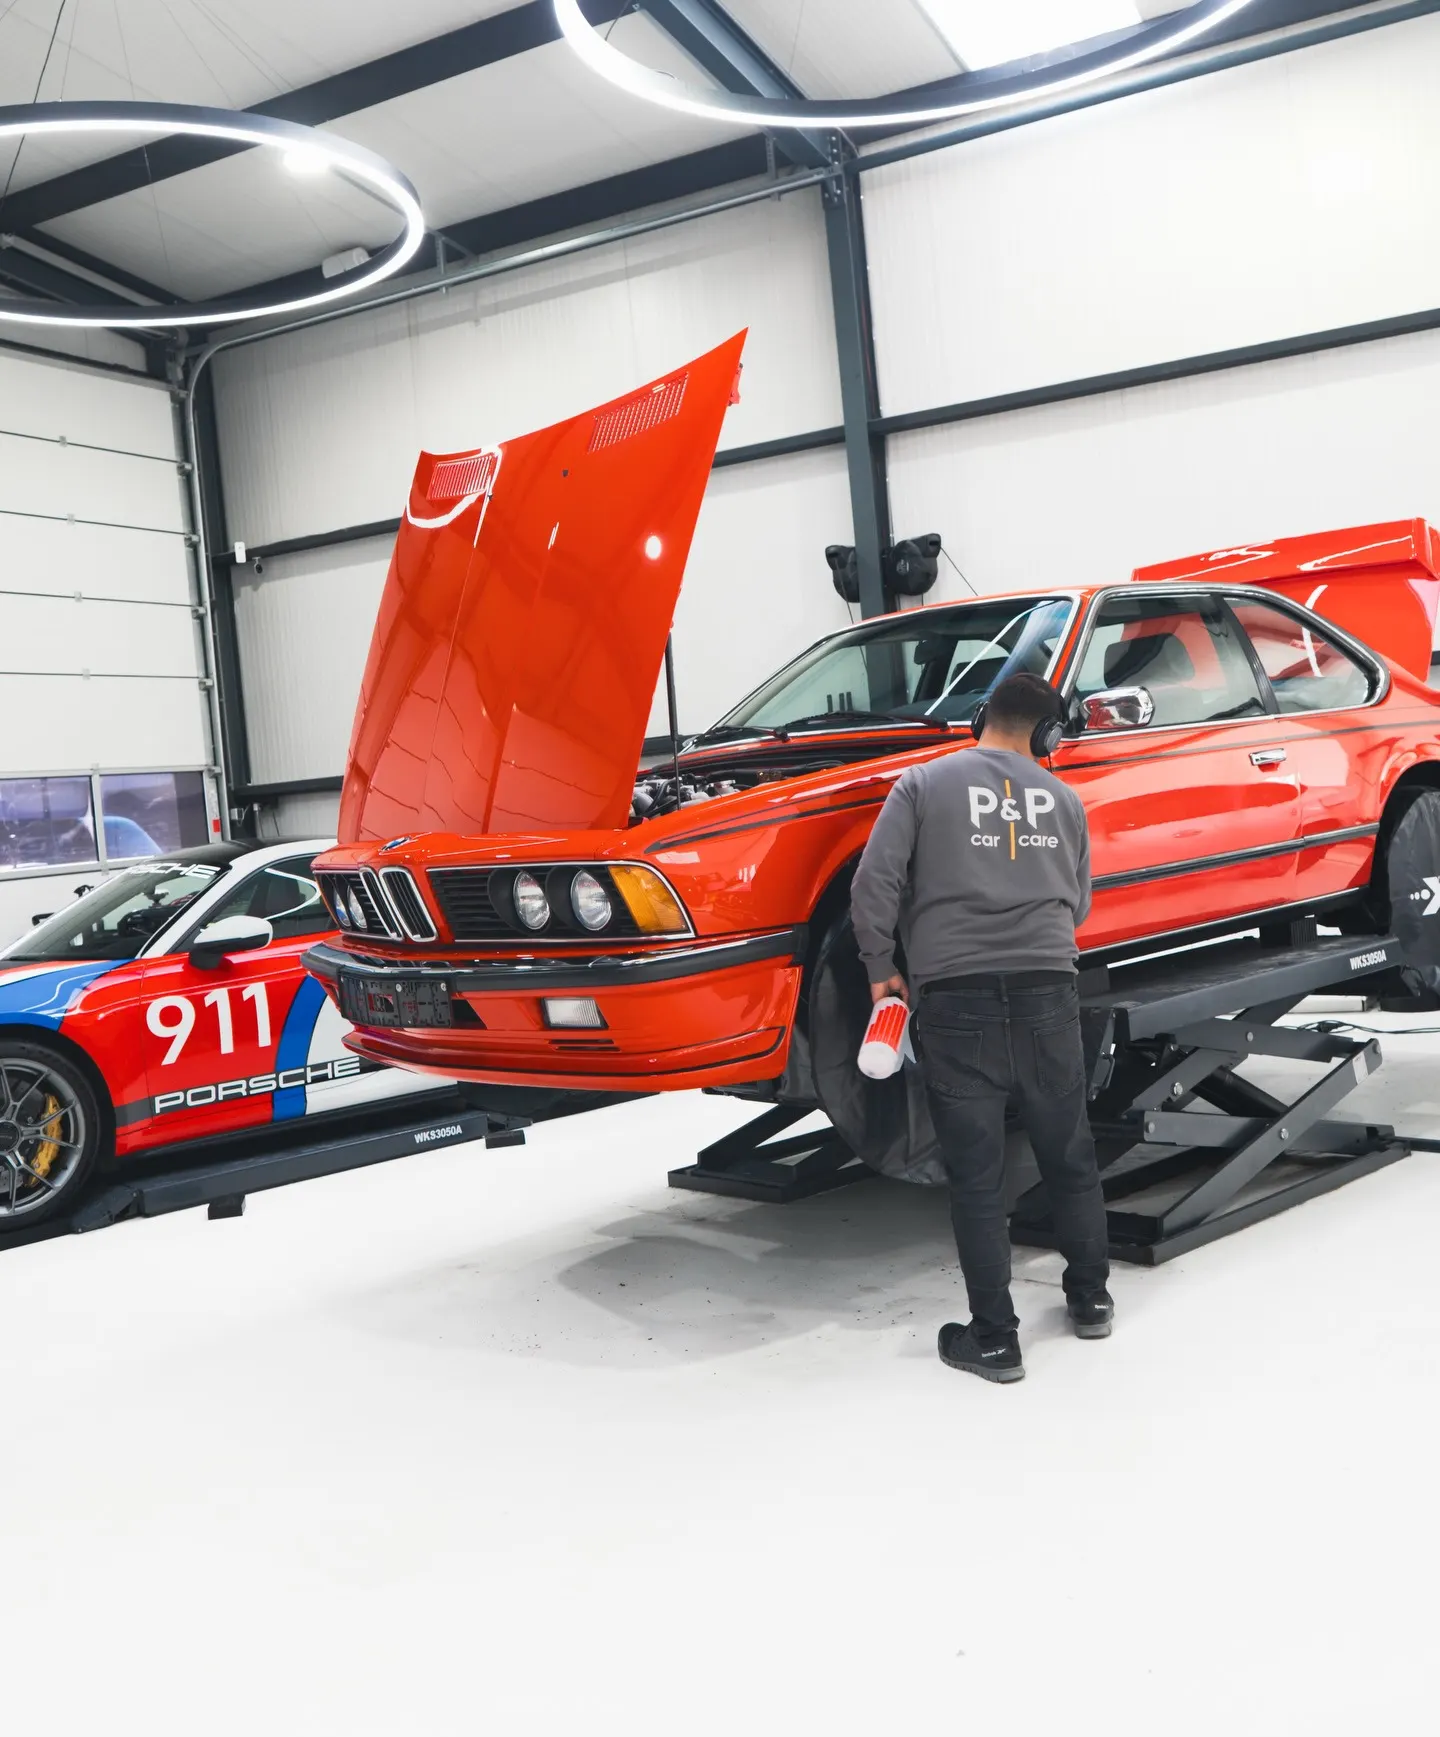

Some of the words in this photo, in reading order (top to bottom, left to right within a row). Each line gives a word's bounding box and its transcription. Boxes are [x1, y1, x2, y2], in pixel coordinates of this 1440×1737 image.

[968, 786, 1055, 830] P&P
[970, 833, 1001, 847] car
[1018, 834, 1059, 848] care
[1349, 949, 1387, 970] WKS3050A
[146, 982, 272, 1066] 911
[154, 1056, 361, 1114] PORSCHE
[414, 1125, 463, 1144] WKS3050A
